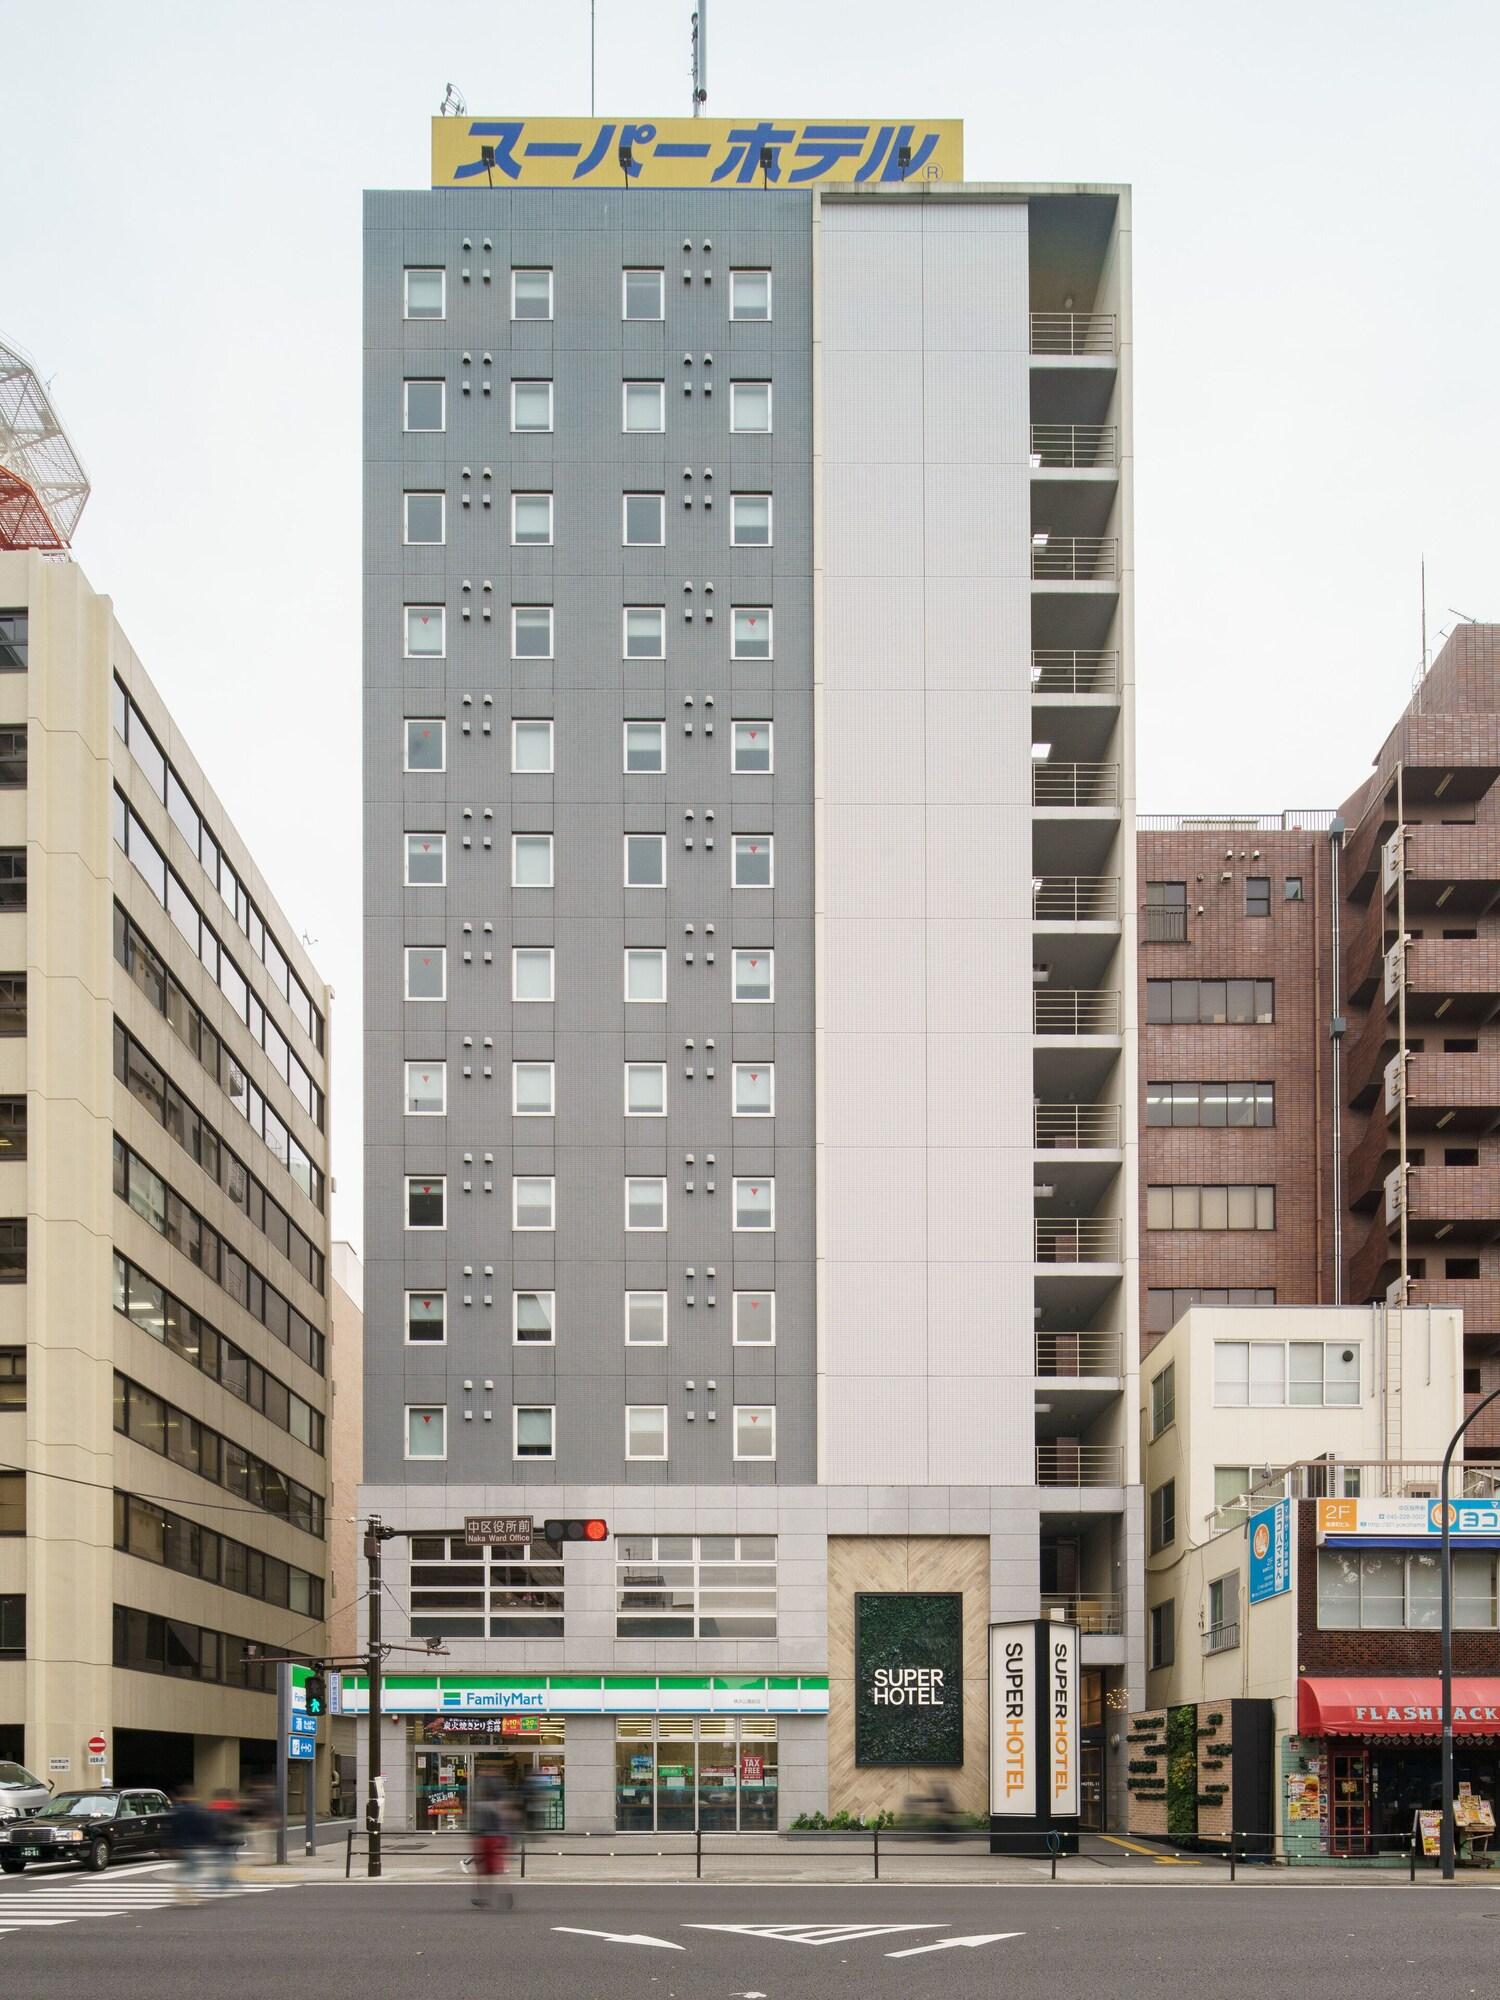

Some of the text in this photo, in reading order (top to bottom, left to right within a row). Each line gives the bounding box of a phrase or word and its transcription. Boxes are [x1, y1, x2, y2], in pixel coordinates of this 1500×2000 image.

[453, 122, 940, 184] スーパーホテル
[1325, 1504, 1350, 1520] 2F
[1463, 1511, 1499, 1528] ヨコ
[468, 1520, 530, 1534] 中区役所前
[468, 1534, 486, 1542] Naka
[874, 1668, 944, 1688] SUPER
[466, 1692, 544, 1707] FamilyMart
[874, 1687, 944, 1705] HOTEL
[744, 1758, 760, 1767] TAX
